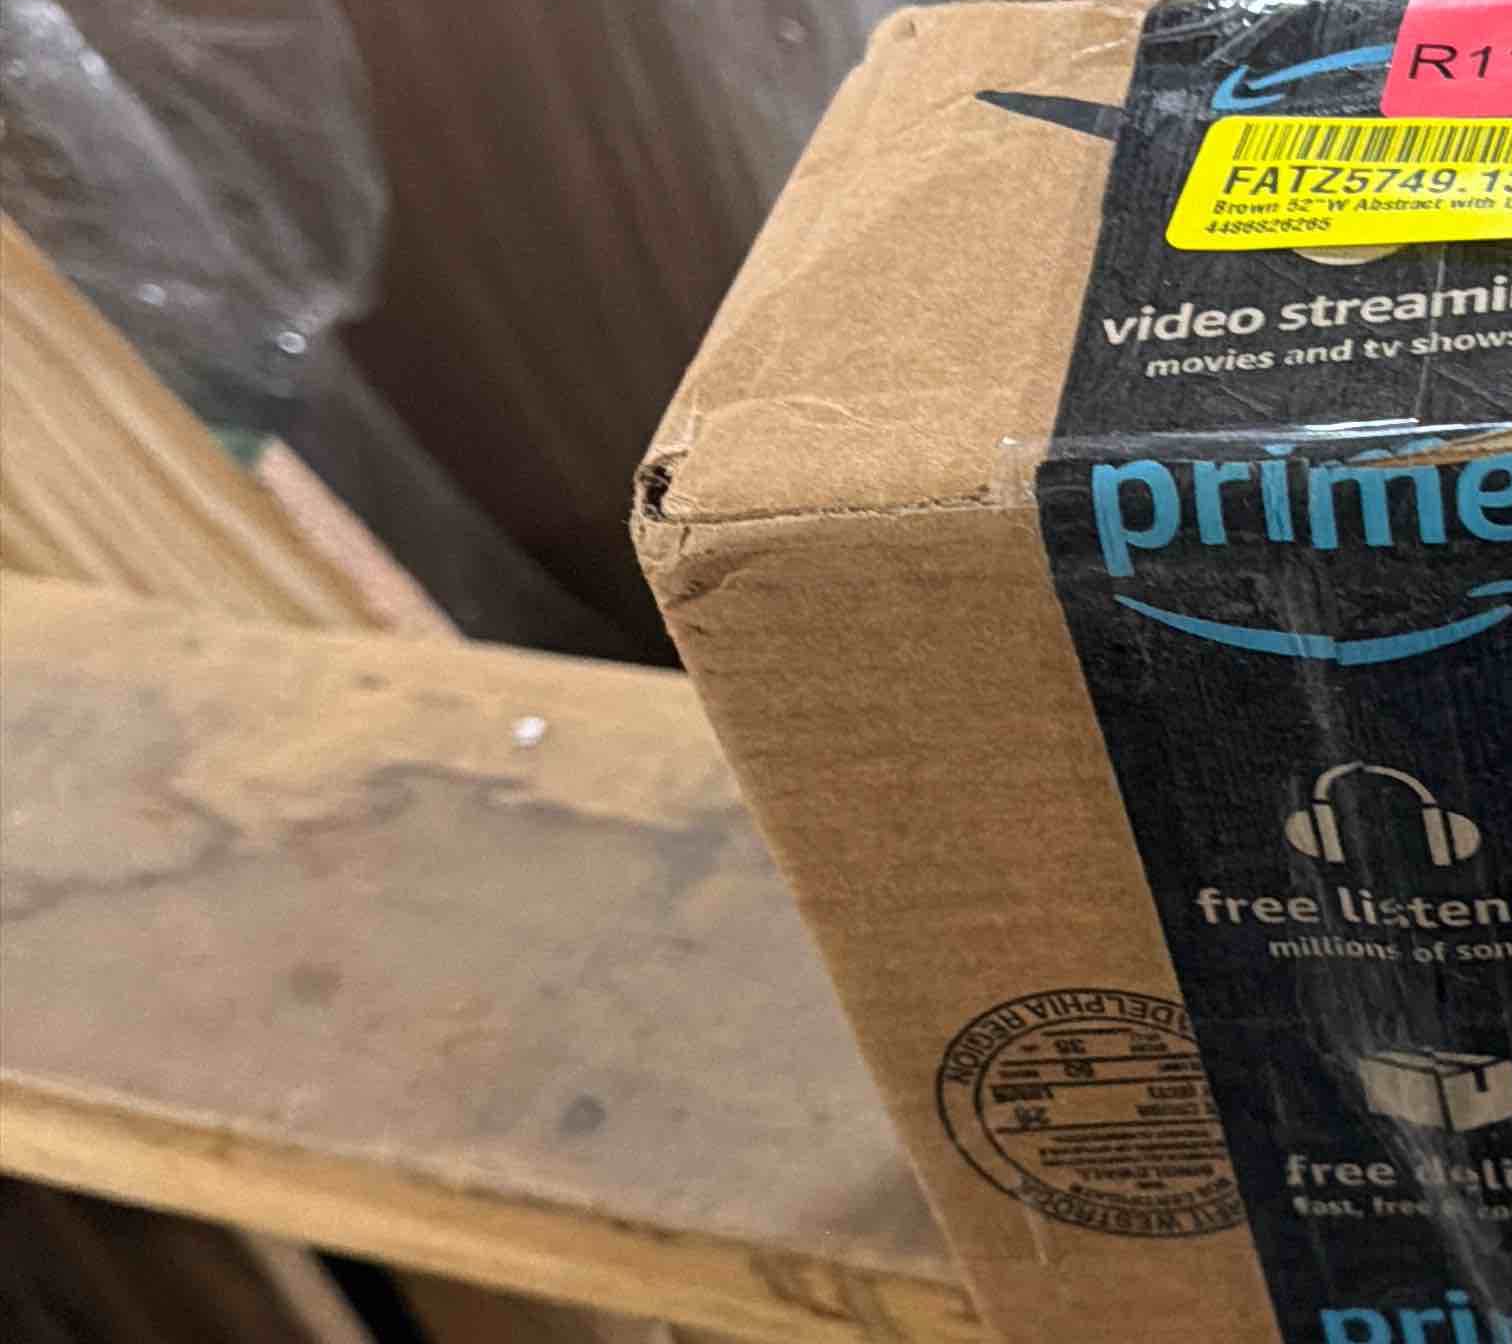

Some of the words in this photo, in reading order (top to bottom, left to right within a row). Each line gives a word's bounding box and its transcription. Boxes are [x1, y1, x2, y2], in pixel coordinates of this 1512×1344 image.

[1212, 198, 1278, 214] Brown
[1354, 196, 1442, 212] Abstract
[1449, 195, 1496, 210] with
[1102, 302, 1266, 346] video
[1144, 350, 1275, 379] movies
[1284, 338, 1353, 367] and
[1363, 337, 1405, 361] tv
[1195, 887, 1320, 926] free
[1413, 940, 1448, 964] of
[944, 1007, 1030, 1086] REGION
[1285, 1154, 1397, 1188] free
